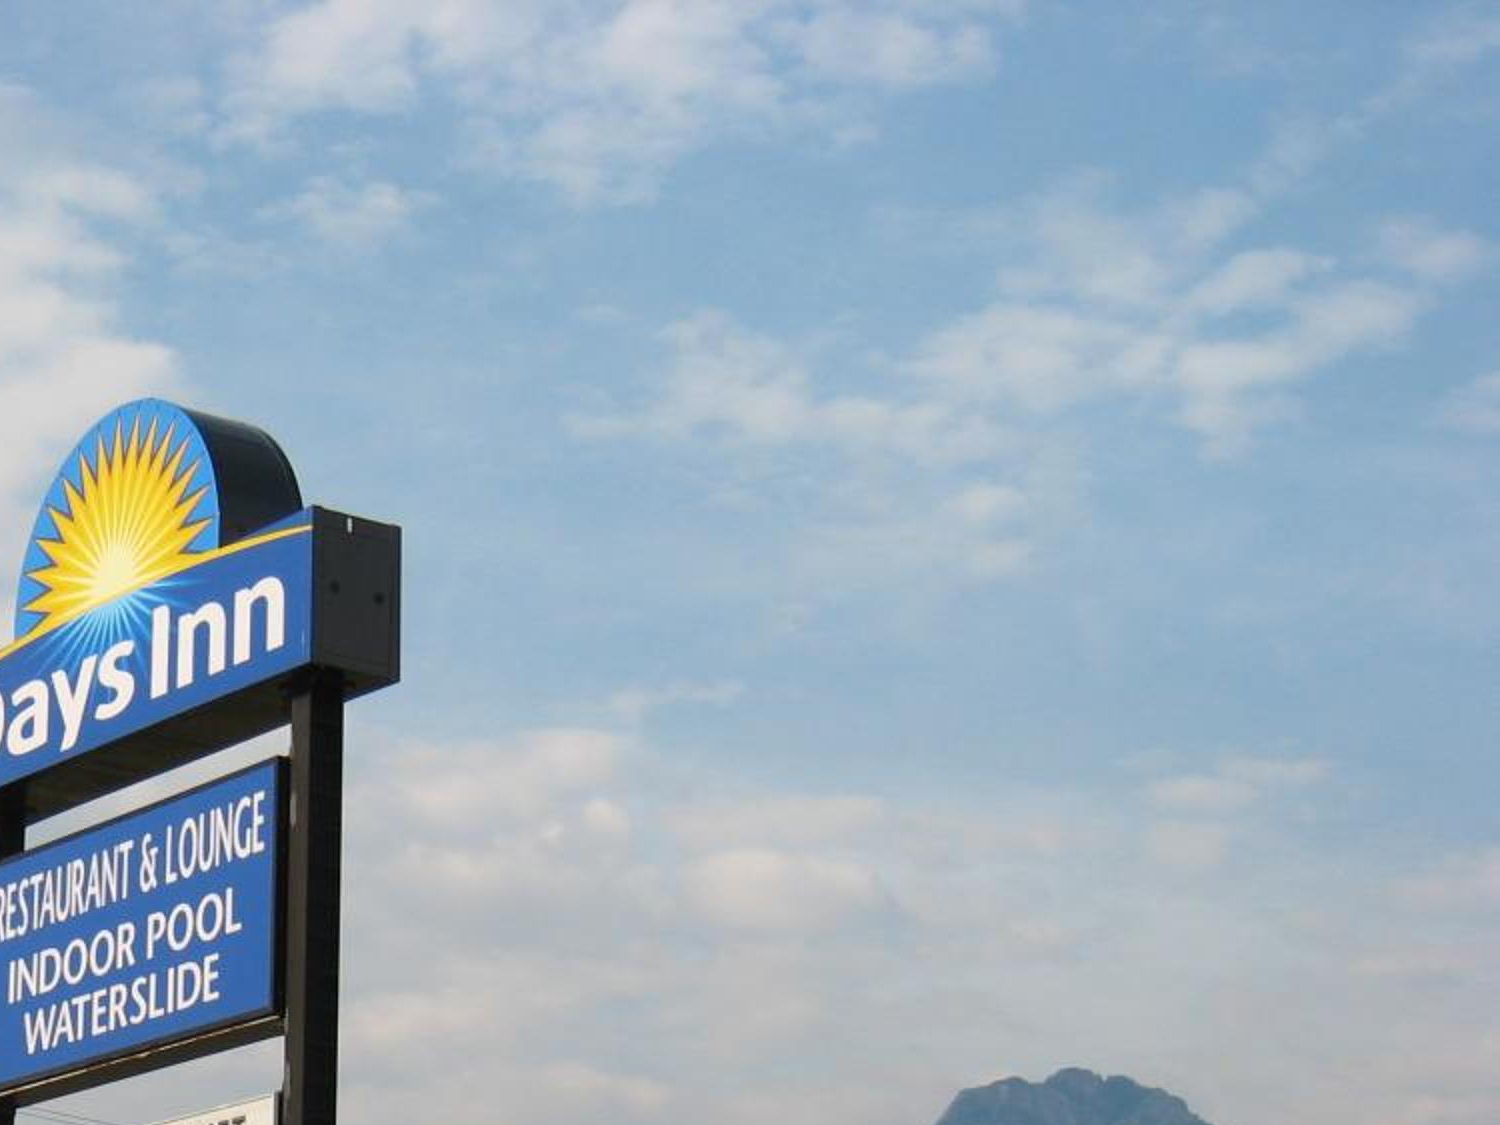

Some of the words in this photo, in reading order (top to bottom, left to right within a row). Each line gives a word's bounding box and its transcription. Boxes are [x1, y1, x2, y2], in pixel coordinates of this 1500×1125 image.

[150, 576, 286, 700] Inn
[139, 832, 158, 893] &
[165, 790, 266, 884] LOUNGE
[7, 921, 135, 1005] INDOOR
[146, 887, 242, 960] POOL
[24, 952, 220, 1055] WATERSLIDE
